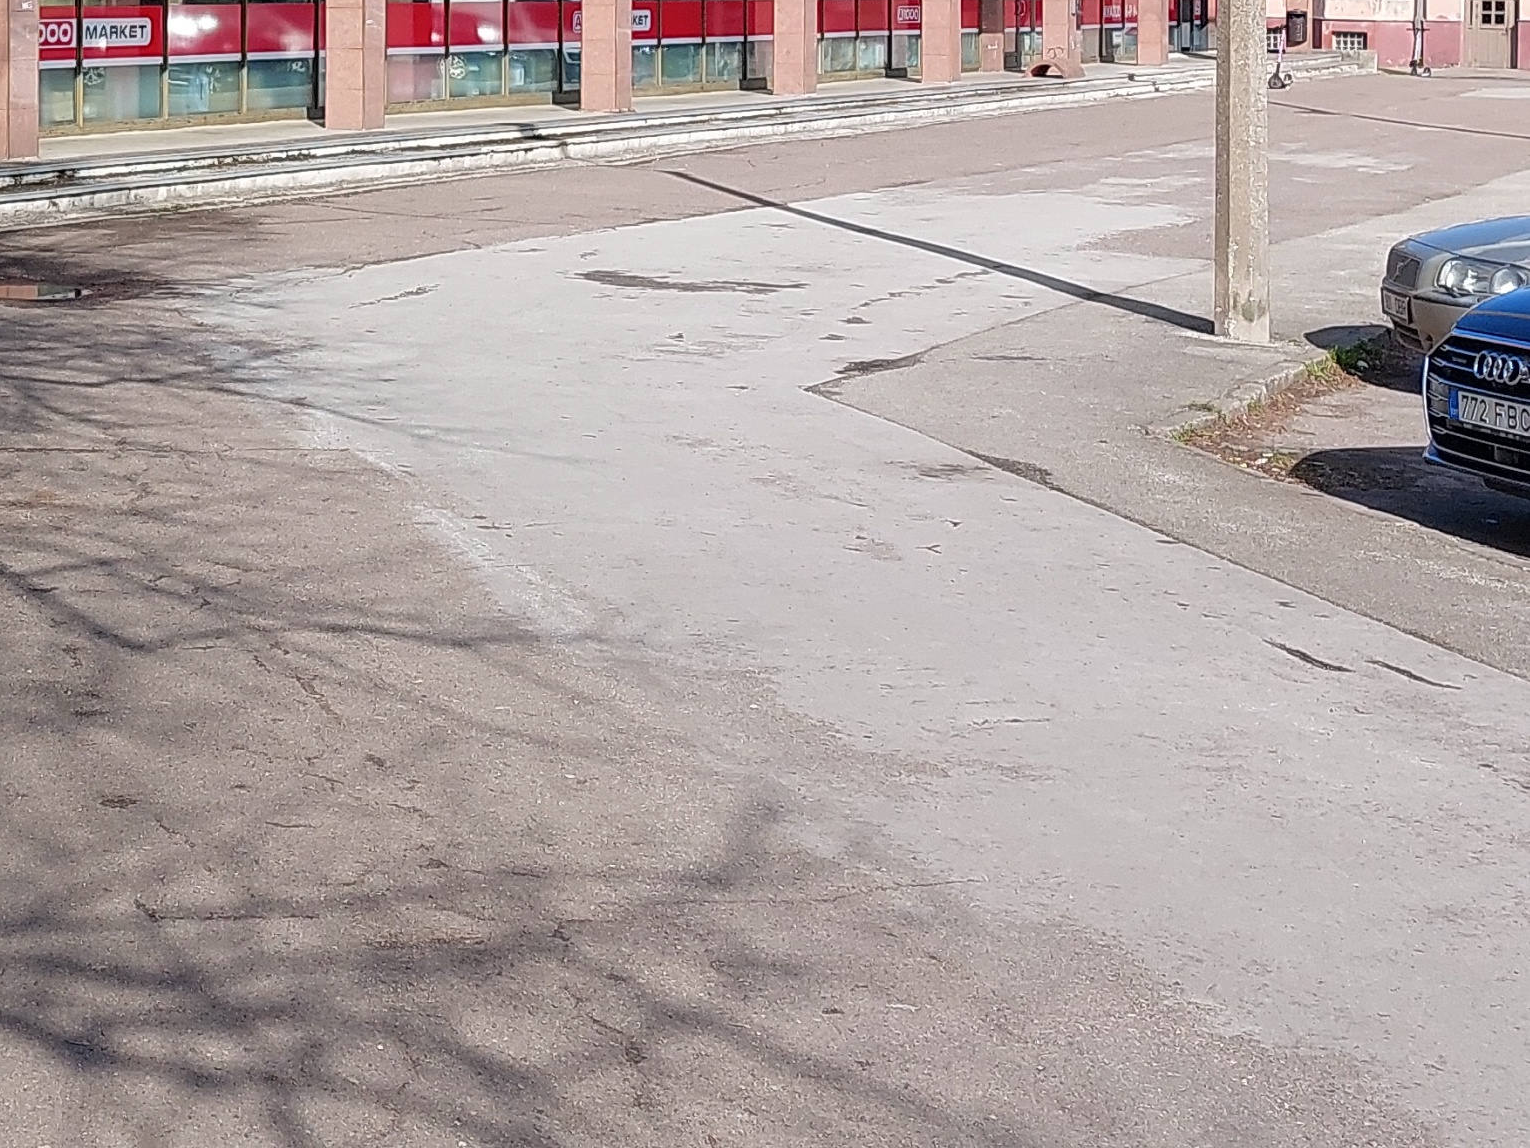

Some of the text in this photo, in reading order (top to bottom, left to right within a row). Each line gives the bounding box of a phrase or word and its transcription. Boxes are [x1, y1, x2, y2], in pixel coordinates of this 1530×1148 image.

[632, 14, 649, 27] KET
[85, 24, 148, 40] MARKET
[1460, 393, 1530, 433] 772 FBC
